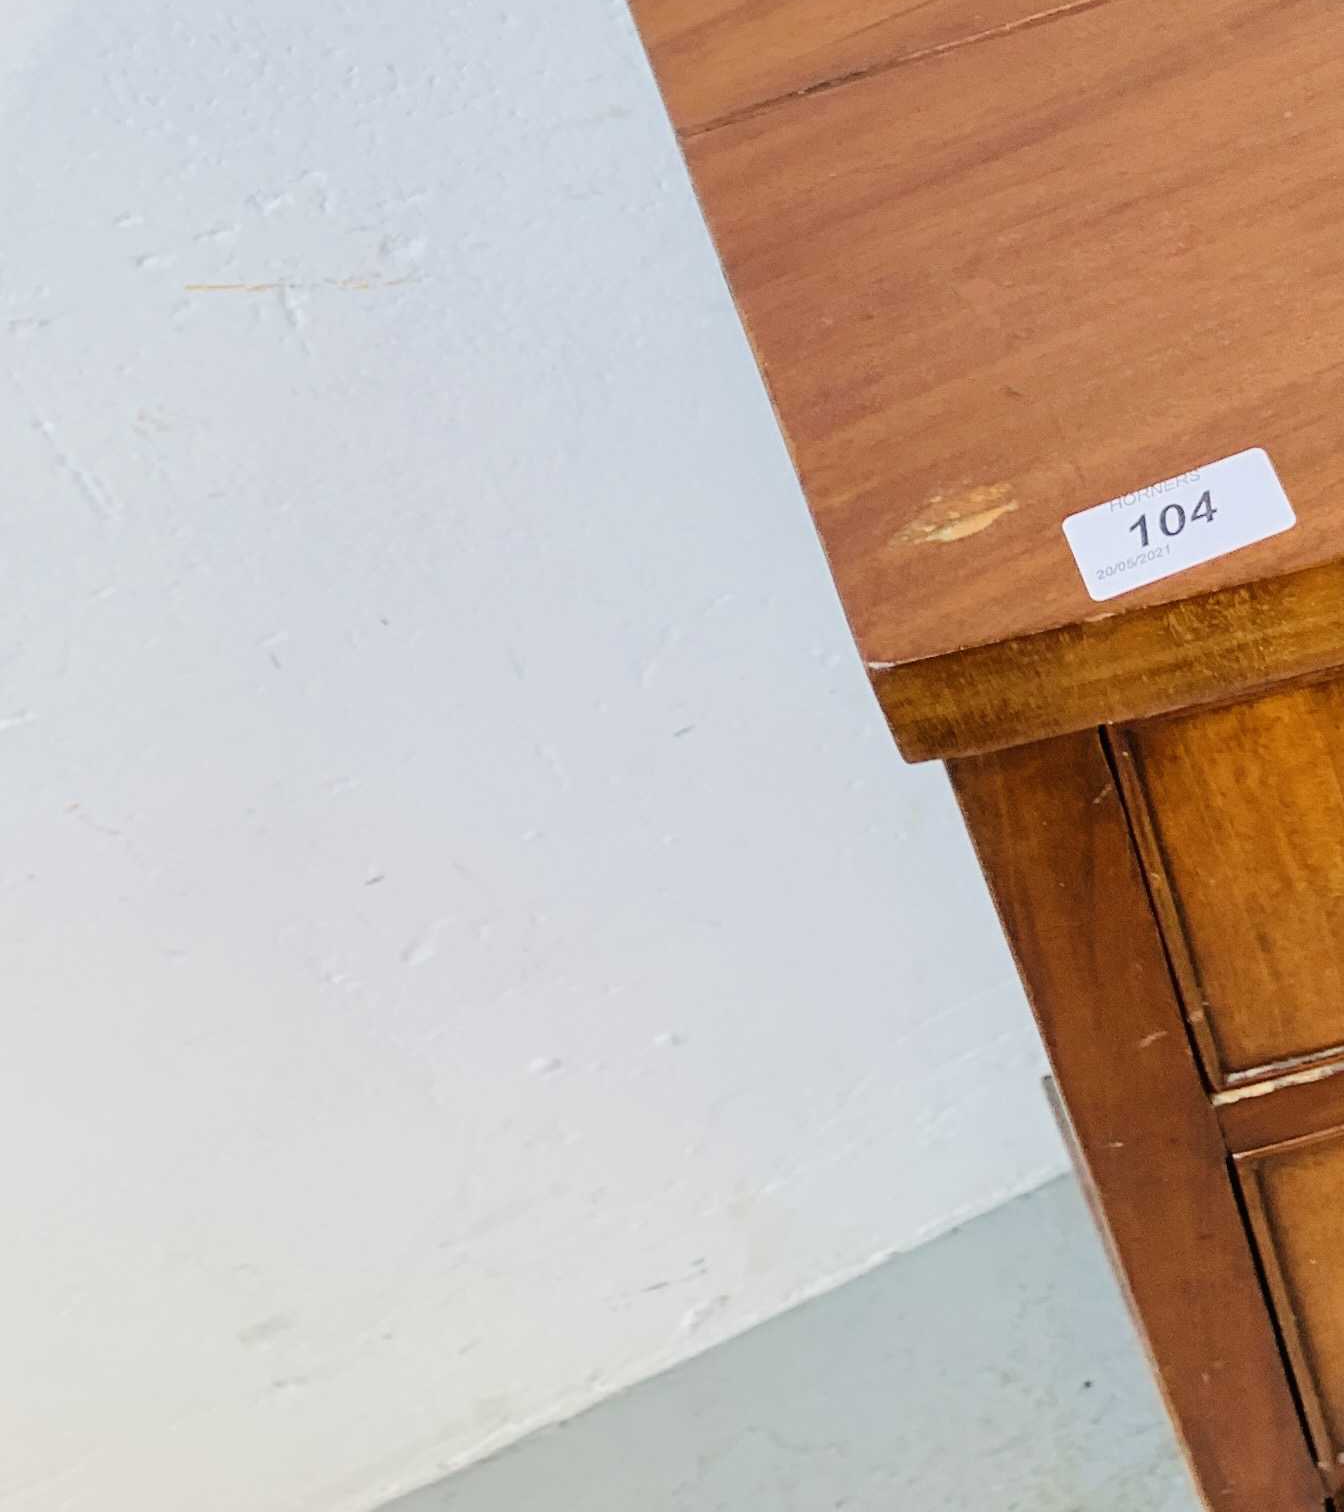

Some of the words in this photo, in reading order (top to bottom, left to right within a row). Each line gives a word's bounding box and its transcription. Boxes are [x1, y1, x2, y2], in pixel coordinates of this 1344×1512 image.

[1109, 469, 1201, 513] HORNERS
[1128, 490, 1218, 547] 104
[1096, 544, 1171, 580] 20/05/2021
